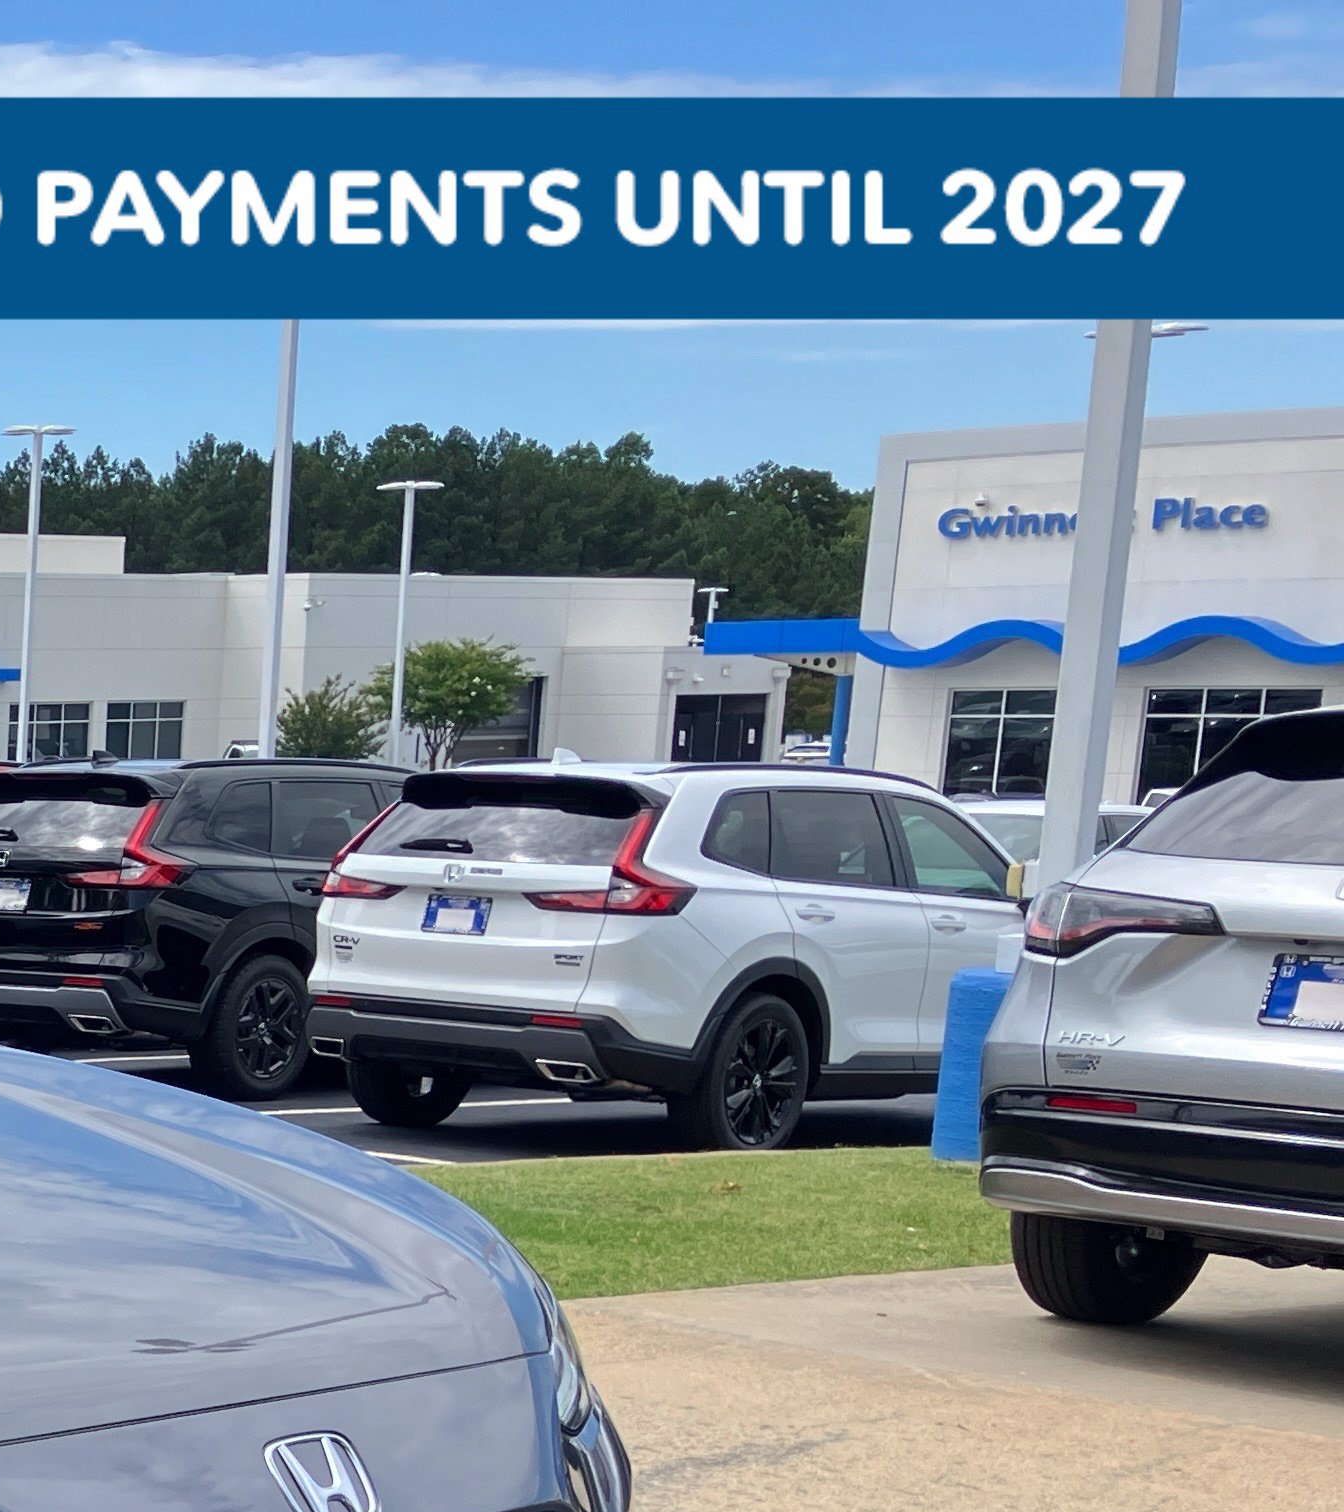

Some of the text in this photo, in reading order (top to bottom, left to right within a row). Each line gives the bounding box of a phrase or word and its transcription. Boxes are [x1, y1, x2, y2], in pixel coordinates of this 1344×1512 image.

[938, 497, 1267, 540] Gwinn Place
[333, 934, 360, 945] CR-V
[1058, 1030, 1126, 1047] HR-V
